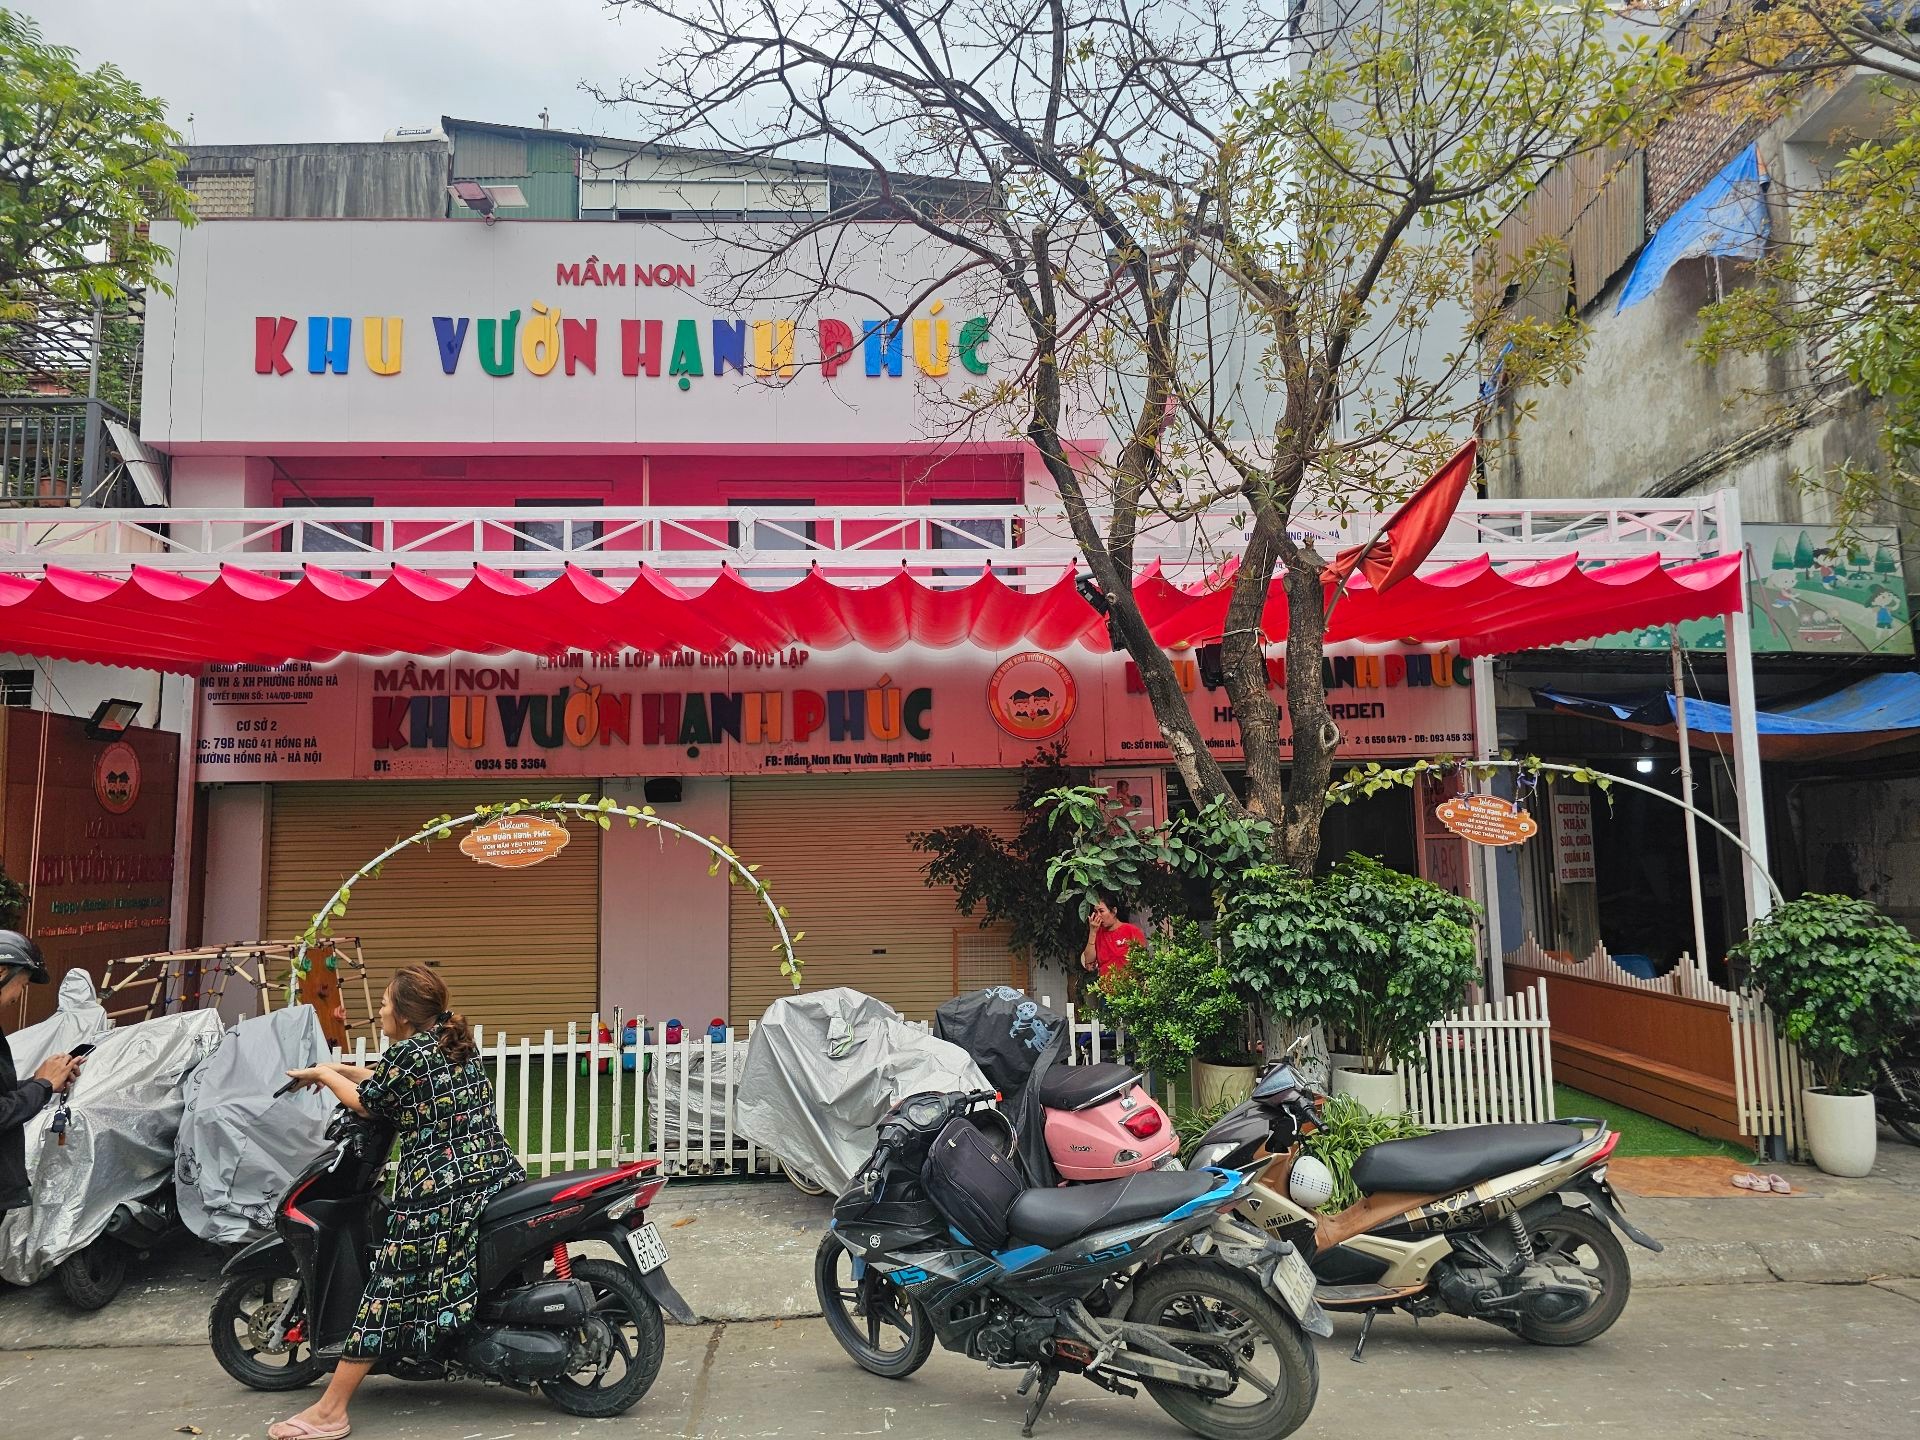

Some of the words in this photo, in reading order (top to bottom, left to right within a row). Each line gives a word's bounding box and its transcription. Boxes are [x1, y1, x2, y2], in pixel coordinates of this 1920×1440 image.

[557, 257, 626, 287] MẦM
[634, 263, 696, 287] NON
[255, 316, 403, 376] KHU
[431, 299, 598, 376] VƯỜN
[621, 317, 796, 392] HẠNH
[818, 299, 989, 377] PHÚC
[779, 647, 809, 669] LẬP
[1384, 646, 1472, 688] PHÚC
[217, 677, 230, 688] VH
[233, 677, 240, 687] &
[243, 677, 255, 687] XH
[257, 674, 295, 687] PHƯỜNG
[297, 672, 324, 687] HỒNG
[325, 674, 338, 686] HÀ
[374, 660, 446, 691] MẦM
[455, 668, 520, 690] NON
[236, 719, 250, 731] CƠ
[253, 717, 268, 731] SỞ
[270, 720, 277, 731] 2
[373, 697, 485, 749] KHU
[496, 677, 631, 748] VƯỜN
[642, 691, 783, 758] HẠNH
[793, 674, 932, 742] PHÚC
[213, 738, 235, 748] 79B
[260, 738, 271, 748] 41
[275, 735, 301, 748] HỒNG
[304, 736, 317, 748] HÀ
[1430, 734, 1445, 743] 093
[195, 751, 231, 764] HƯỜNG
[234, 750, 261, 763] HỒNG
[264, 751, 278, 763] HÀ
[288, 751, 301, 763] HÀ
[304, 751, 322, 764] NỘI
[475, 759, 501, 770] 0934
[504, 759, 519, 770] 56
[520, 759, 547, 770] 3364
[765, 755, 783, 767] FB:
[810, 753, 831, 766] Non
[832, 753, 852, 765] Khu
[854, 752, 878, 764] Vườn
[880, 752, 905, 767] Hạnh
[907, 750, 932, 764] Phúc
[1265, 1213, 1294, 1228] AMAHA
[632, 1225, 657, 1250] 29-B1
[638, 1242, 667, 1270] 879.18
